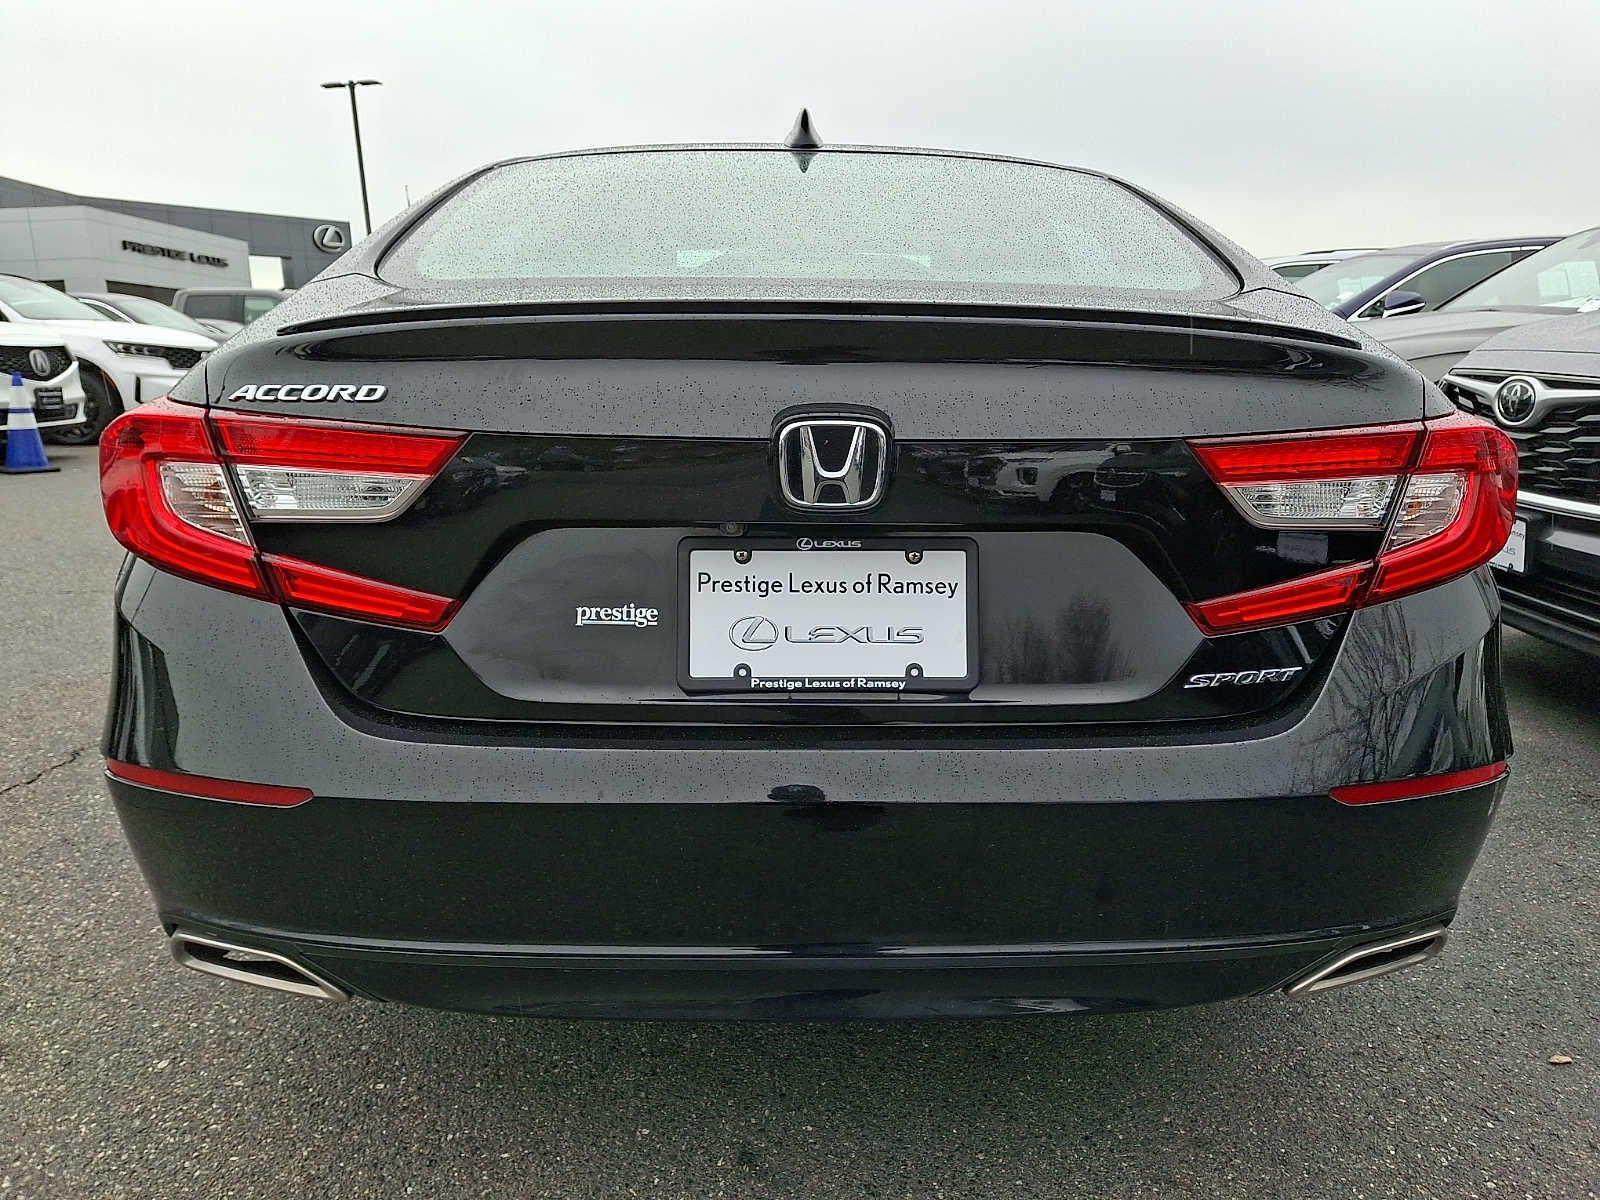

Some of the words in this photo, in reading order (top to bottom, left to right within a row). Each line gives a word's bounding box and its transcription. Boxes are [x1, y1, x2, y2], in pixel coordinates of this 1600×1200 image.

[228, 384, 388, 402] ACCORD
[813, 540, 863, 548] LEXUS
[697, 571, 784, 598] Prestige
[788, 572, 848, 594] Lexus
[852, 573, 873, 594] of
[877, 573, 959, 599] Ramsey
[575, 603, 659, 628] prestige
[784, 625, 925, 645] LEXUS
[750, 678, 803, 690] Prestige
[804, 678, 842, 689] Lexus
[842, 678, 856, 689] of
[857, 678, 906, 690] Ramsey
[1183, 666, 1303, 689] SPORT
